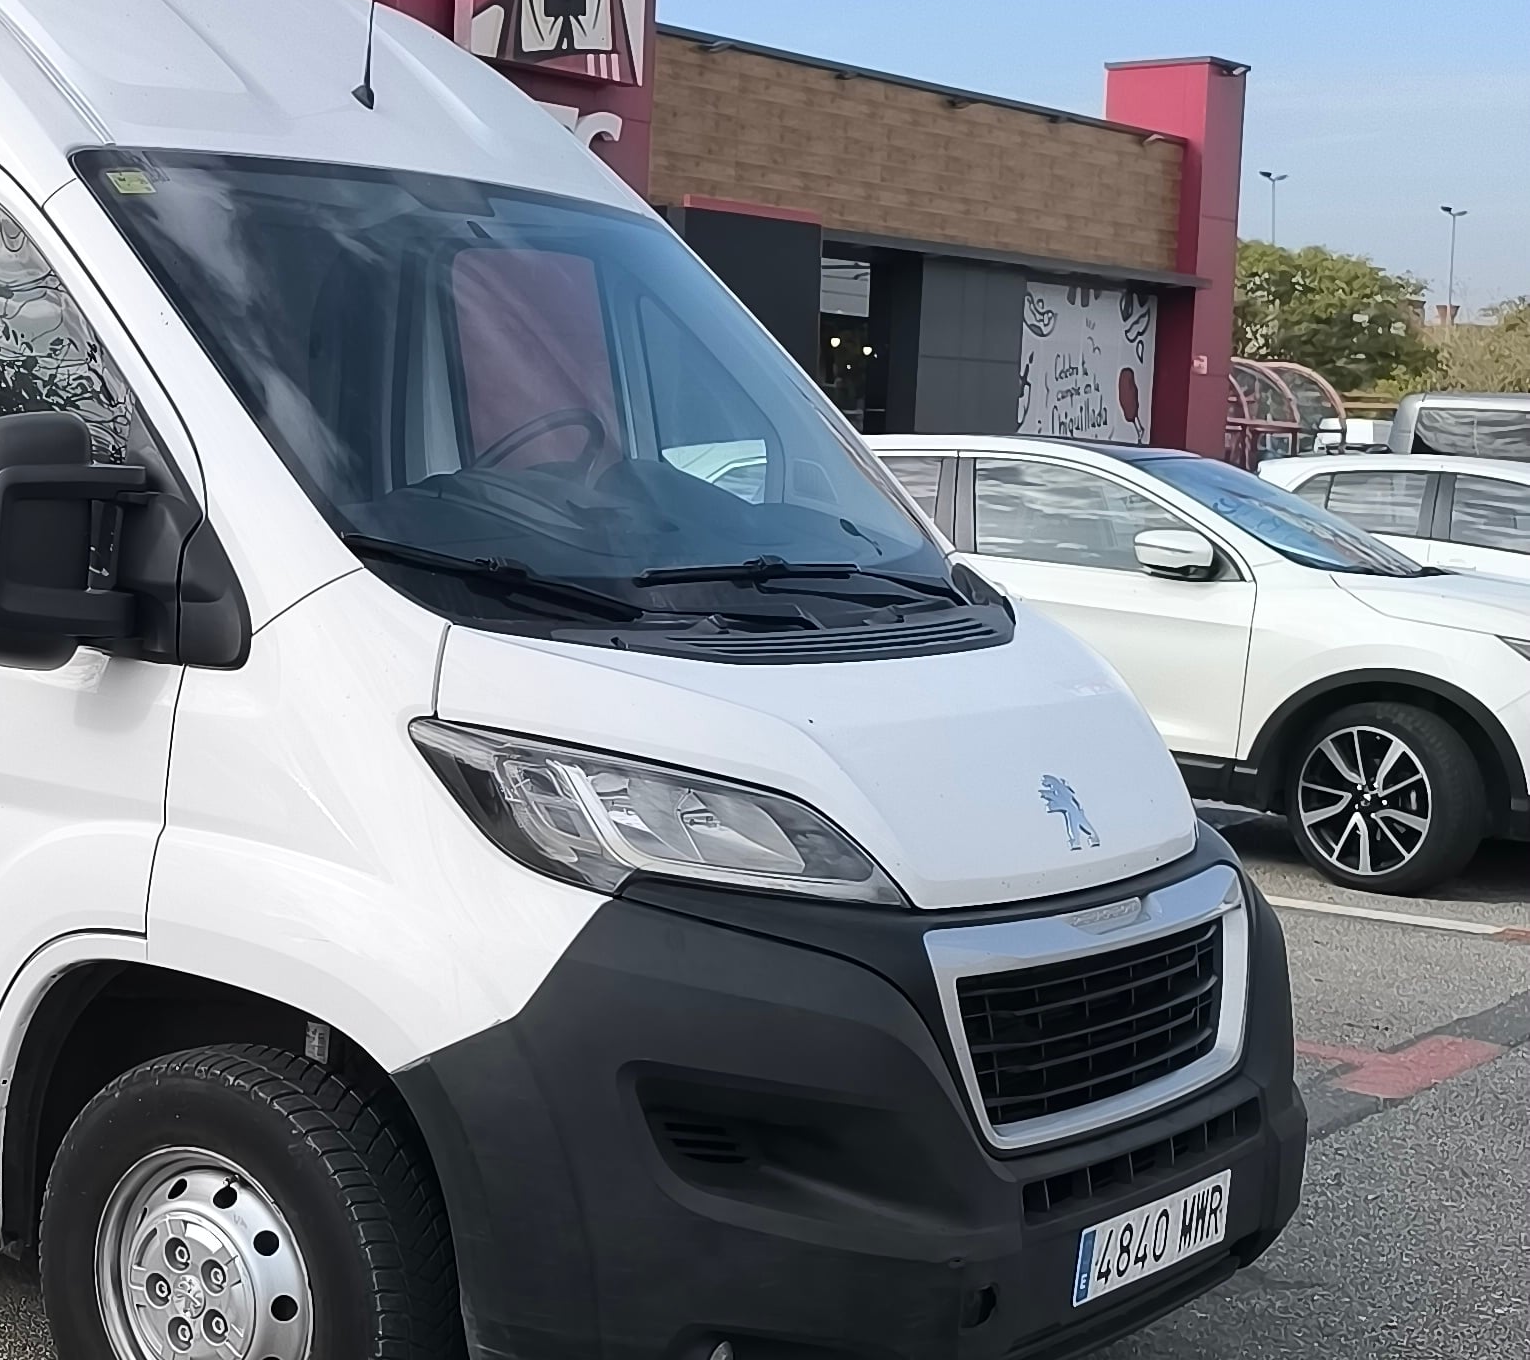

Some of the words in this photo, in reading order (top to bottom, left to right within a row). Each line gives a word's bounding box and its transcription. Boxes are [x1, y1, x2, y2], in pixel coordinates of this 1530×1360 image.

[1095, 1208, 1170, 1285] 4840
[1178, 1184, 1223, 1253] MWR
[1079, 1273, 1088, 1290] E
